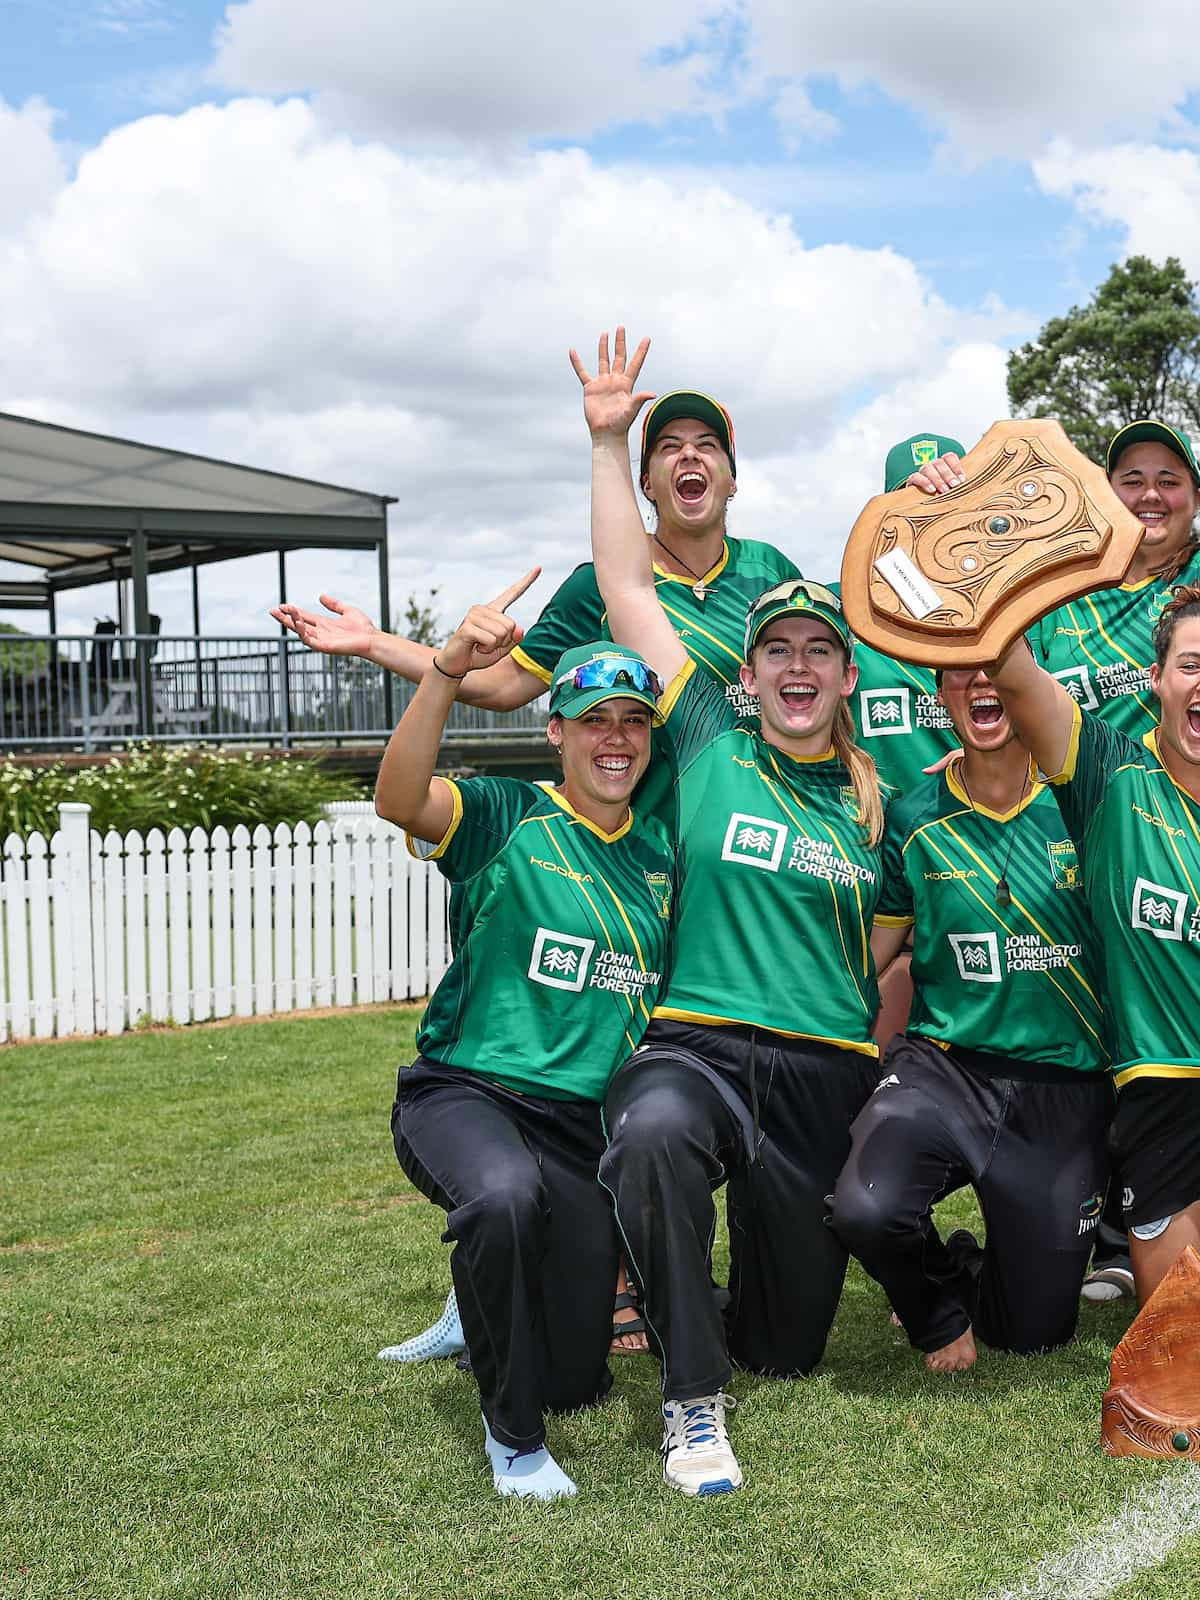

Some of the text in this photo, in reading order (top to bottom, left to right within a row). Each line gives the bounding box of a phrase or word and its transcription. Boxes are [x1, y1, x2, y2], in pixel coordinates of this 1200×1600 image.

[1095, 661, 1128, 679] JOHN
[1096, 668, 1151, 689] TURKING
[725, 683, 747, 697] JOH
[1101, 679, 1152, 699] FORESTR
[915, 694, 938, 706] JOH
[916, 716, 954, 729] FORES
[792, 835, 833, 855] JOHN
[530, 856, 594, 883] KOOGA
[788, 857, 858, 888] FORESTRY
[791, 845, 876, 885] TURKINGTON
[923, 870, 979, 880] KOOGA
[1004, 935, 1040, 950] JOHN
[596, 950, 634, 967] JOHN
[1007, 956, 1071, 973] FORESTRY
[589, 975, 645, 996] FORESTR
